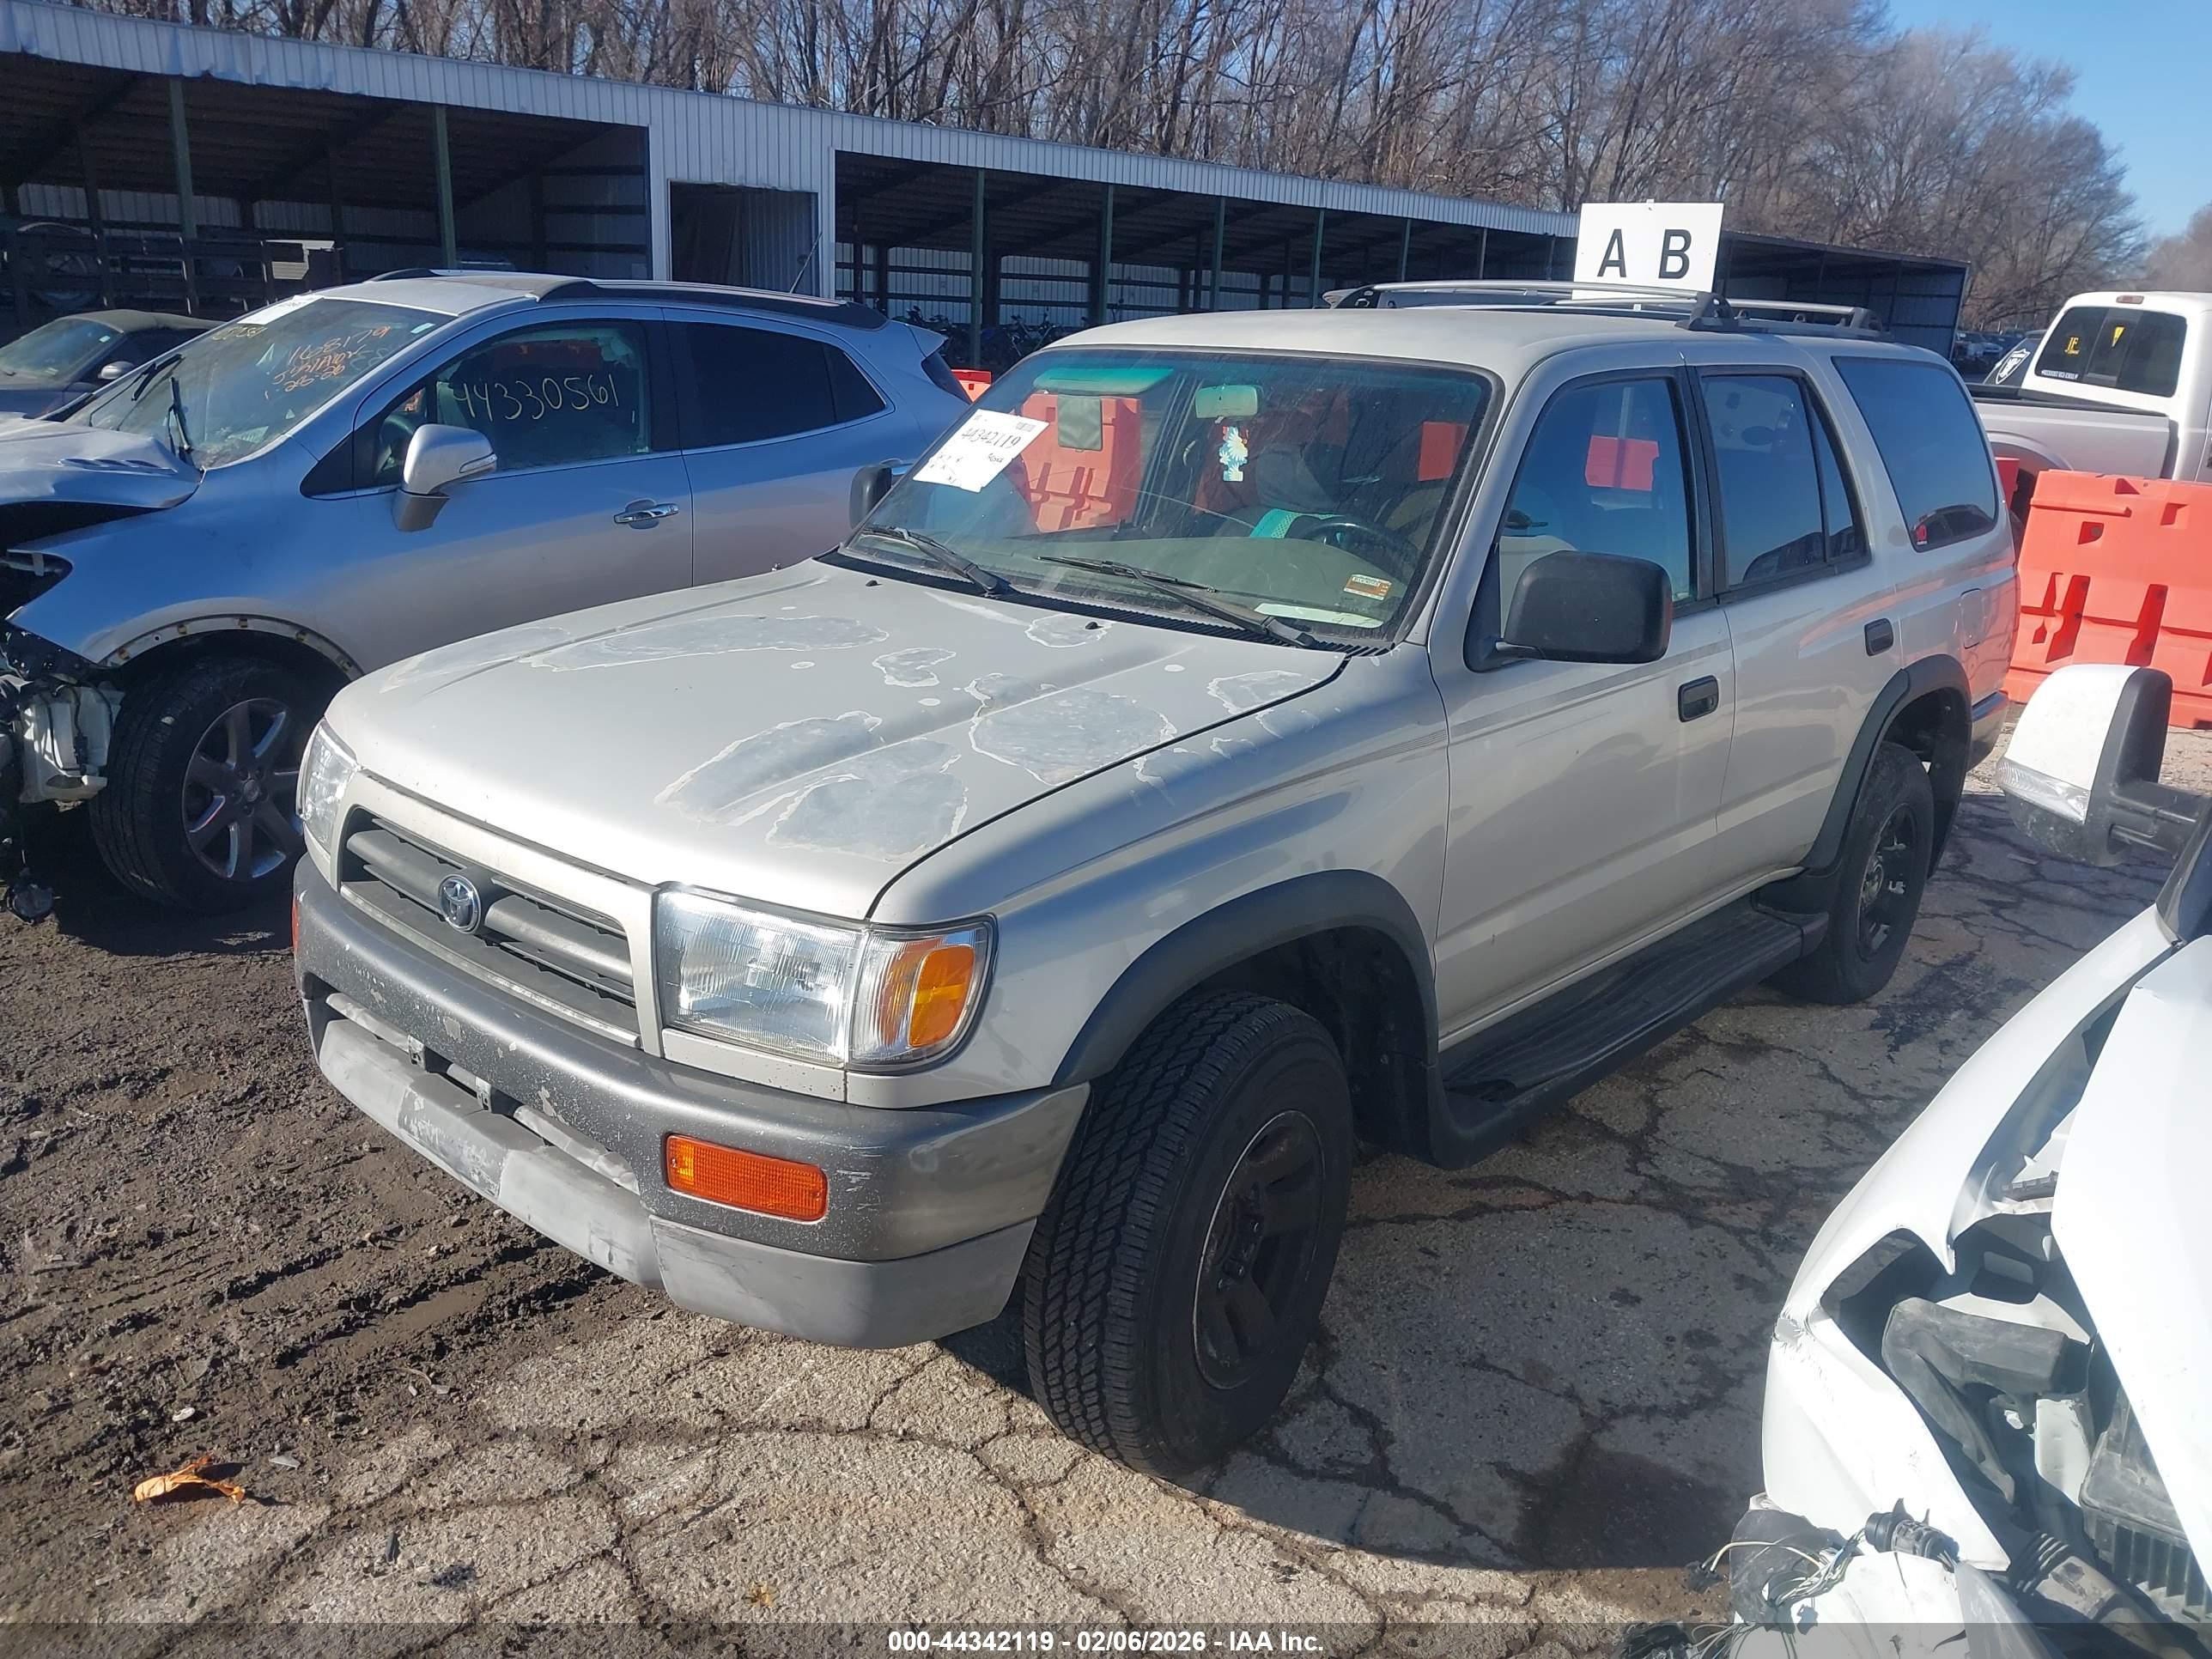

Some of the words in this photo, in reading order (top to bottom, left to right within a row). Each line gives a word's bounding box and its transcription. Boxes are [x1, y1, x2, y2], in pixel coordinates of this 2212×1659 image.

[1597, 228, 1627, 278] A
[1658, 228, 1692, 279] B
[453, 374, 619, 422] 44330561
